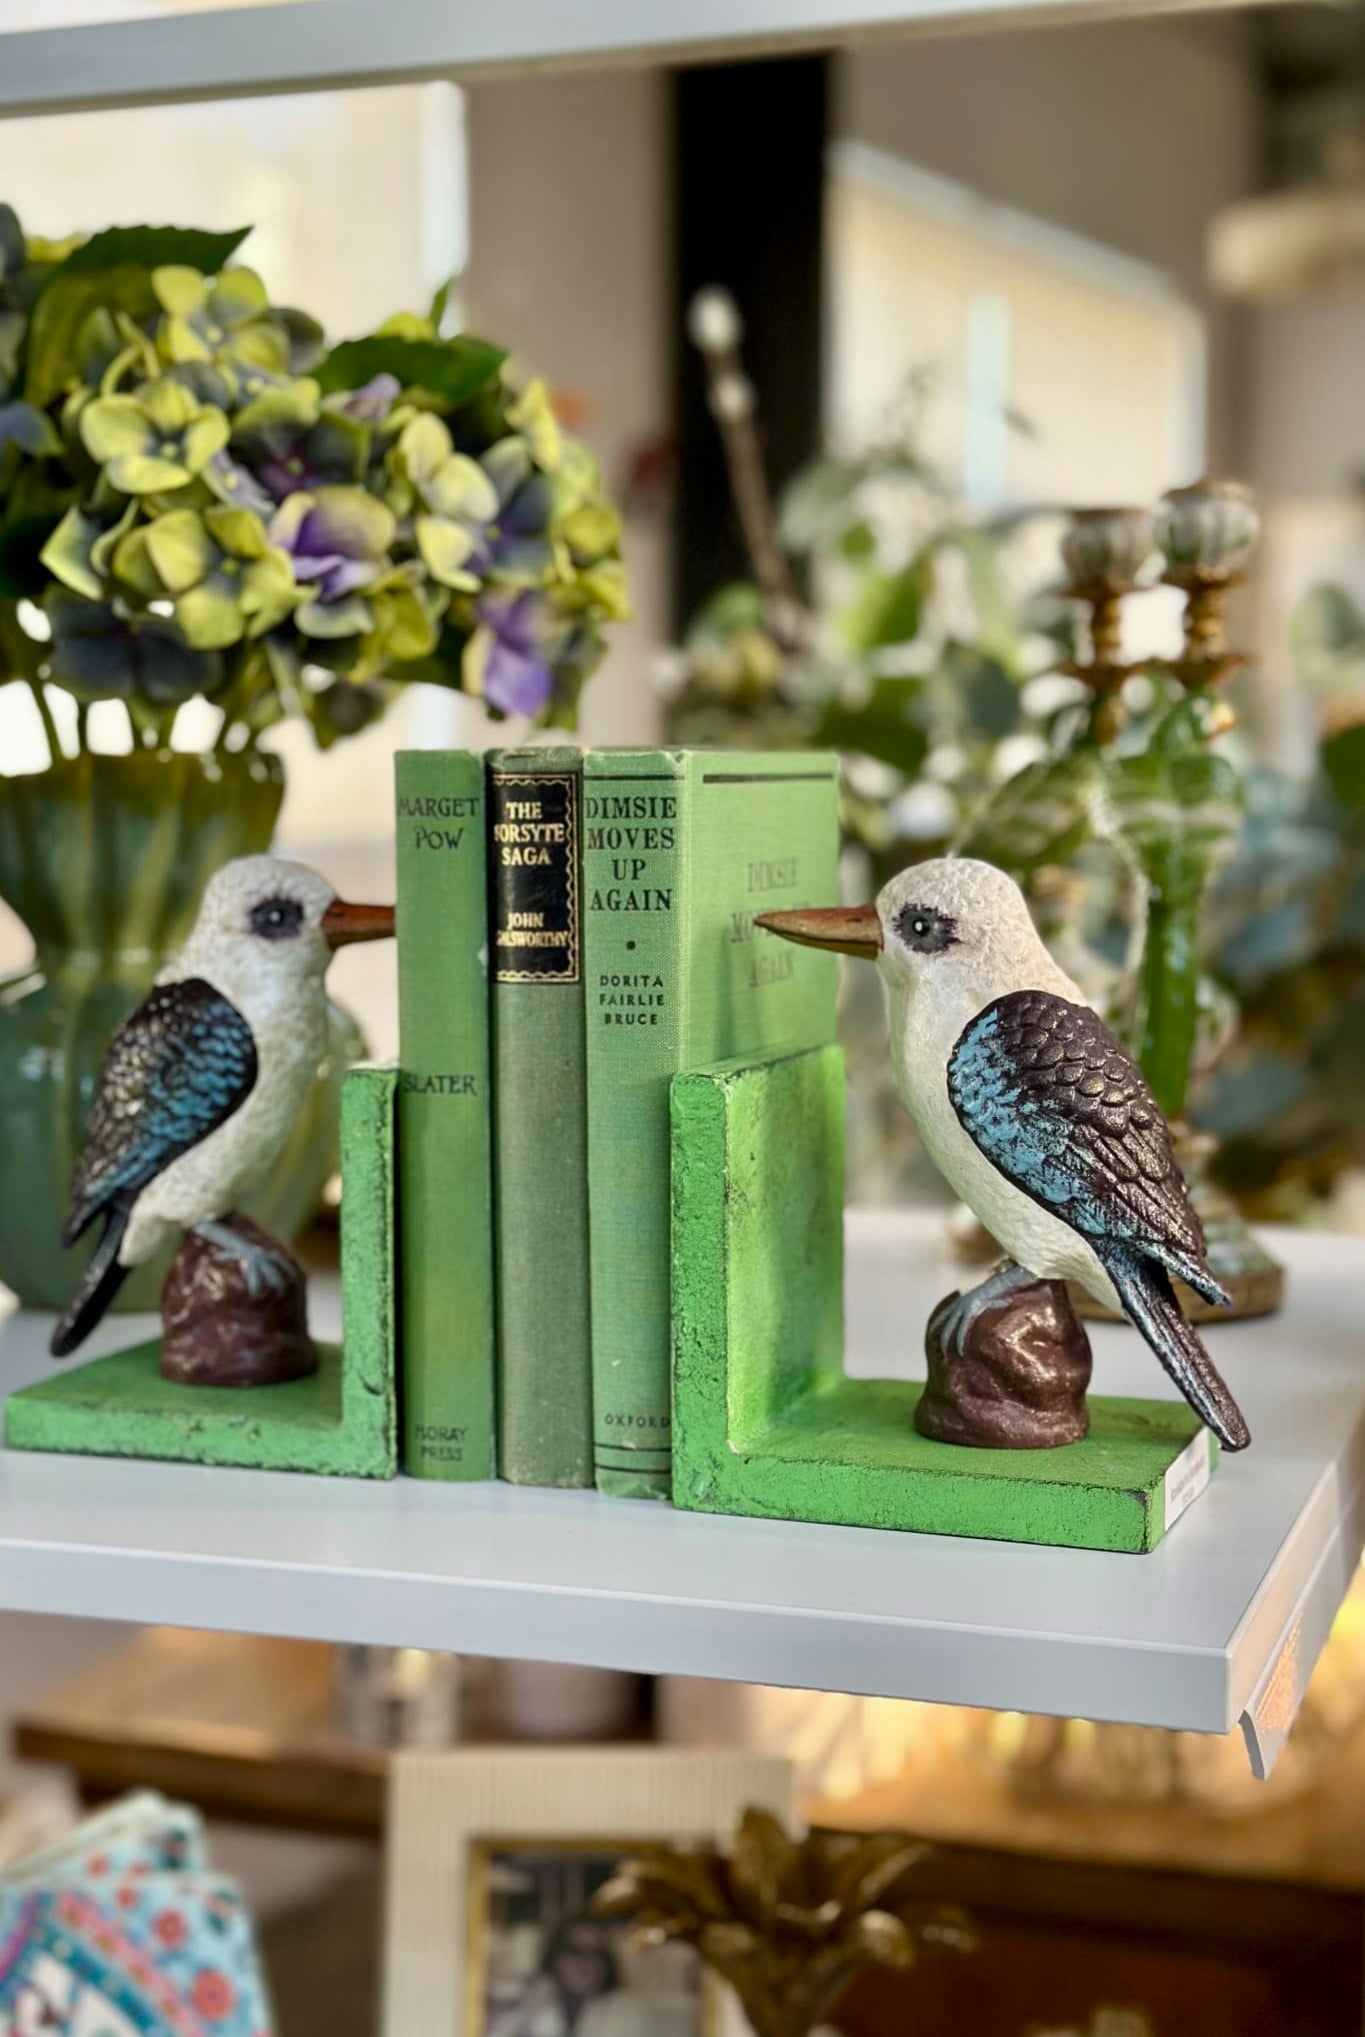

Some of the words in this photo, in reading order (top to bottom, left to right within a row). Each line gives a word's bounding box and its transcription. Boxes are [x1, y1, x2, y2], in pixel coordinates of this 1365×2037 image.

[505, 801, 543, 820] THE
[583, 796, 677, 819] DIMSIE
[413, 826, 465, 850] POW
[494, 823, 565, 843] FORSYTE
[587, 827, 674, 850] MOVES
[502, 847, 552, 867] SAGA
[612, 858, 646, 881] UP
[590, 888, 672, 912] AGAIN
[506, 912, 544, 930] JOHN
[600, 975, 664, 988] DORITA
[599, 994, 665, 1006] FAIRLIE
[604, 1013, 658, 1025] BRUCE
[402, 1072, 478, 1097] SLATER
[604, 1412, 671, 1429] OXFORD
